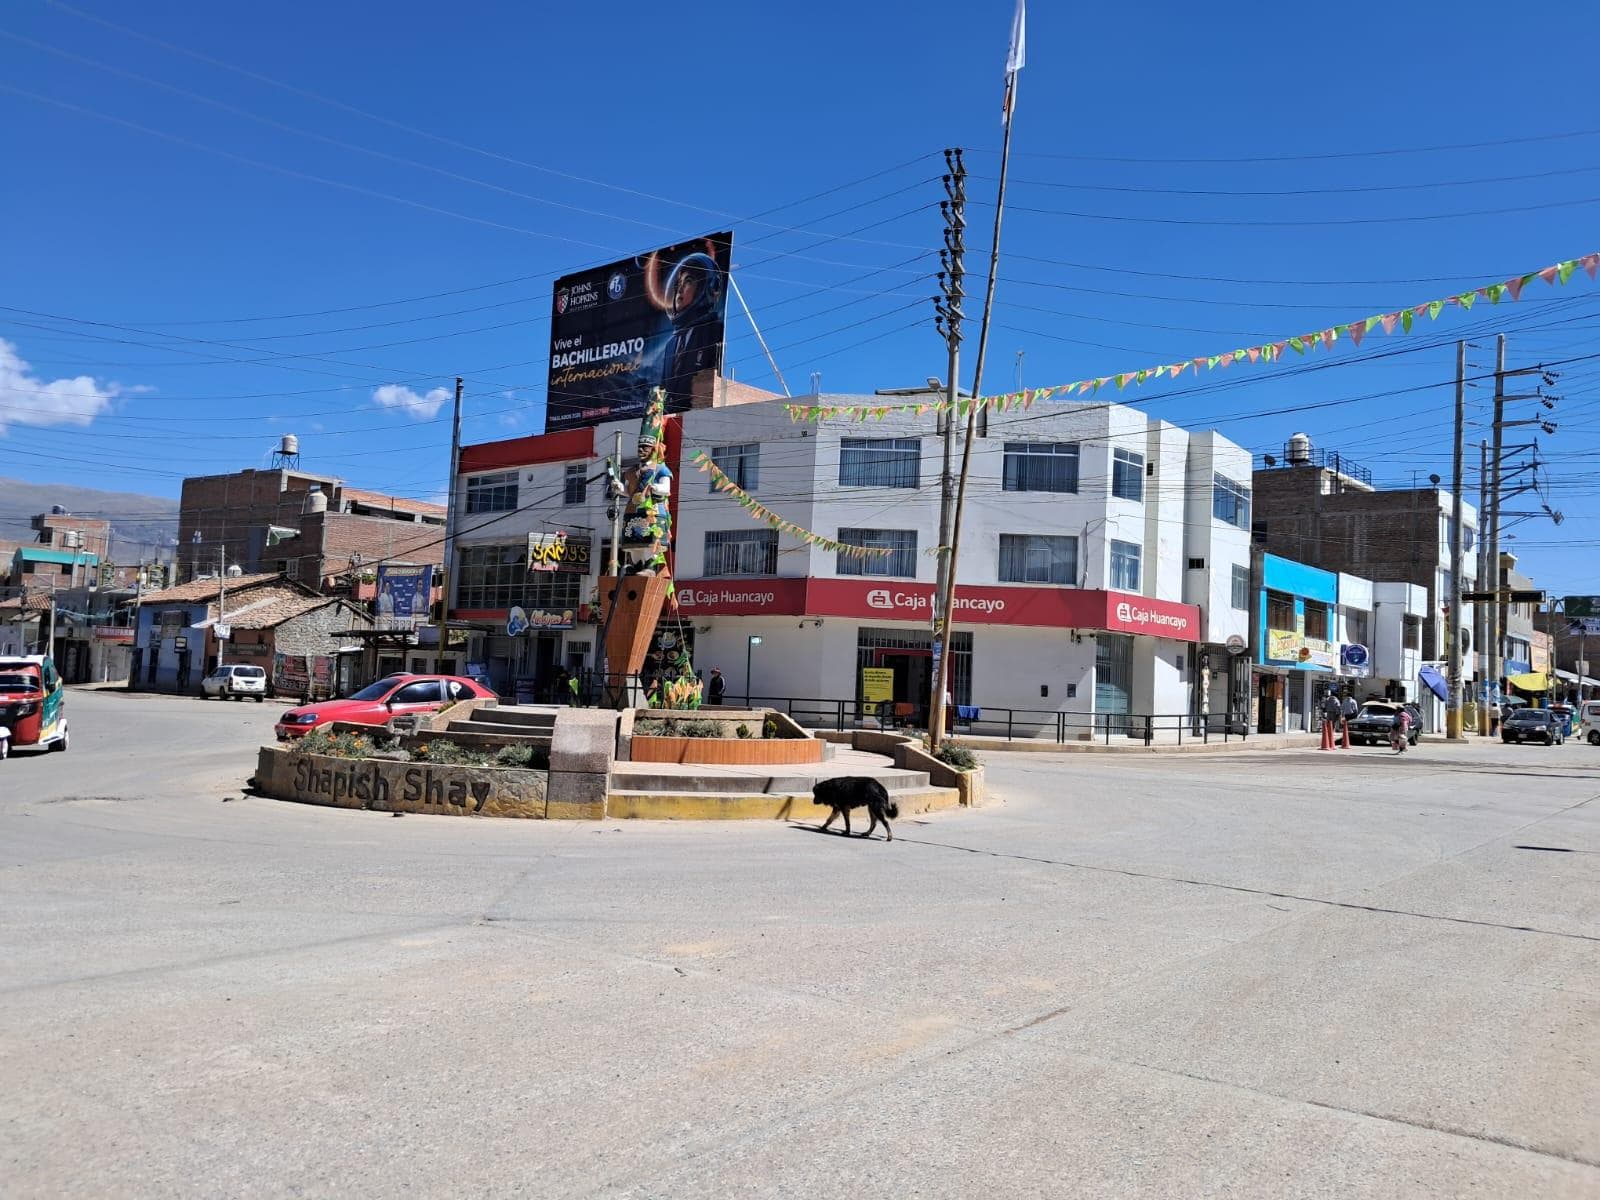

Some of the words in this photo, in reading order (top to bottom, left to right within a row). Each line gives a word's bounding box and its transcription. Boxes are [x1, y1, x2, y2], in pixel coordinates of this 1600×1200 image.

[570, 291, 599, 306] HOPKINS
[571, 282, 592, 298] JOHNS
[554, 339, 573, 351] Vive
[574, 335, 582, 347] el
[552, 337, 645, 369] BACHILLERATO
[696, 590, 719, 606] Caja
[720, 590, 775, 606] Huancayo
[894, 592, 927, 611] Caja
[931, 592, 1005, 613] ancayo
[1131, 606, 1149, 625] Caja
[1150, 610, 1187, 630] Huancayo
[293, 758, 390, 802] Shapish
[403, 768, 491, 813] Shay
